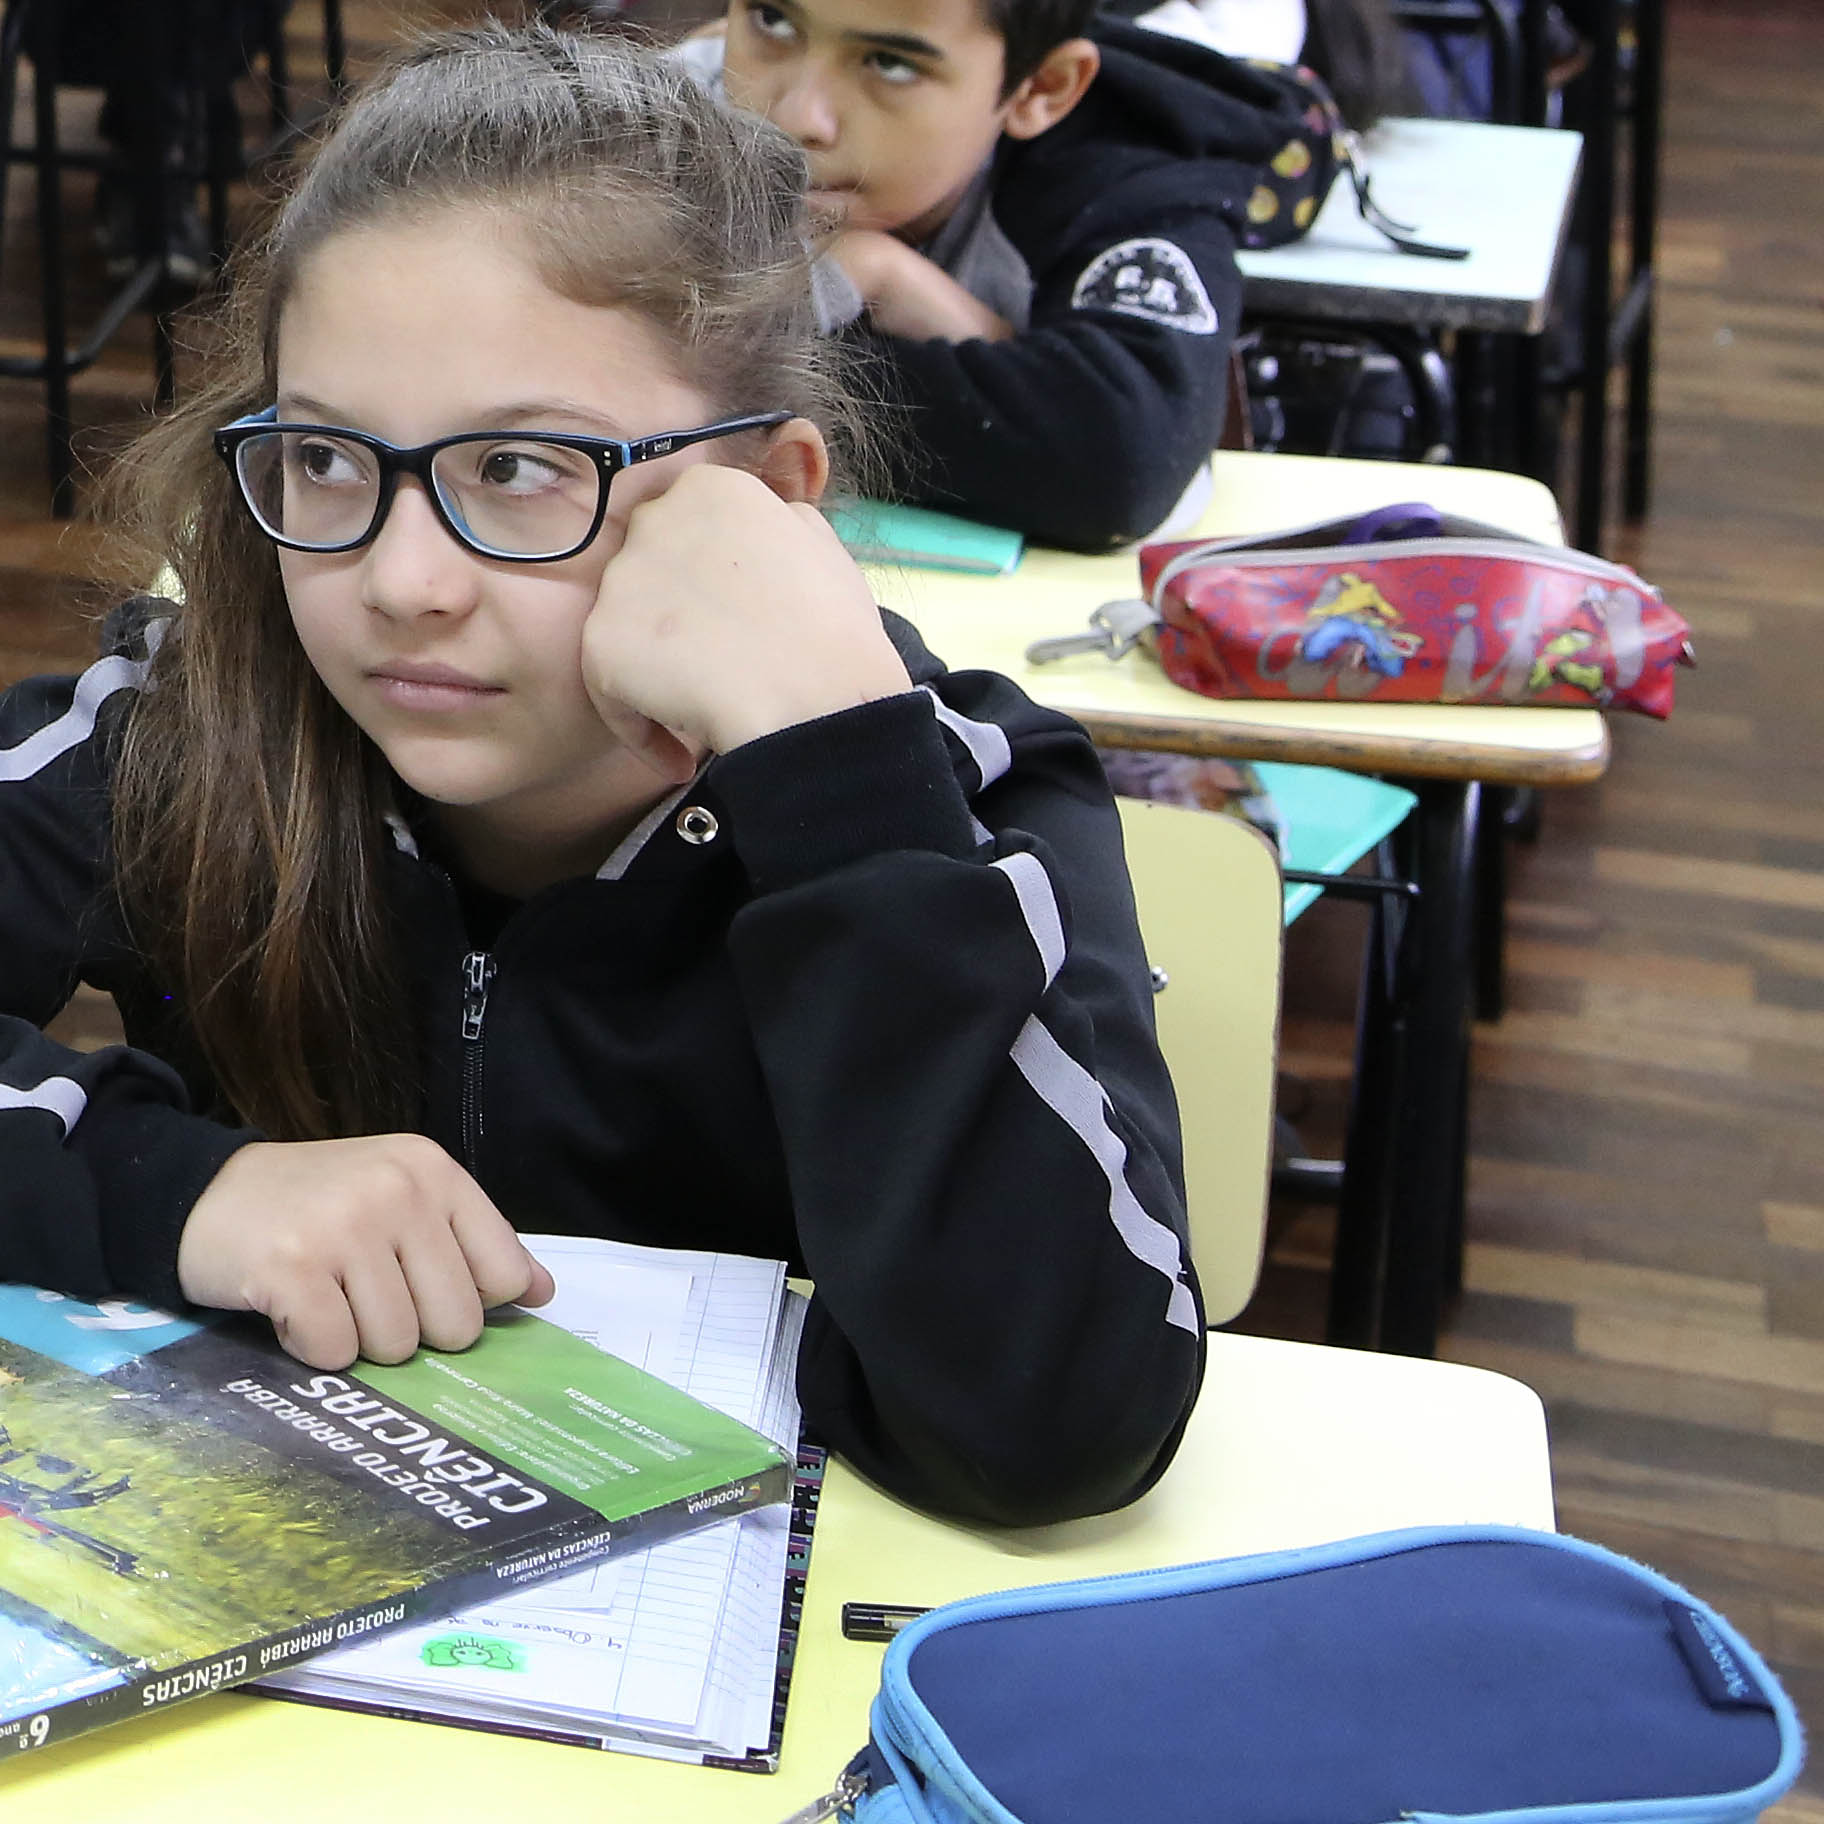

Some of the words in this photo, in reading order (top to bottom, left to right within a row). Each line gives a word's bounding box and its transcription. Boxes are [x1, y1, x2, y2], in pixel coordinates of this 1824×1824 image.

[219, 1379, 364, 1453] ARARIBÁ
[290, 1375, 549, 1514] CIÊNCIAS
[352, 1452, 491, 1531] PROJETO
[686, 1485, 746, 1515] MODERNA
[548, 1546, 563, 1560] DA
[563, 1530, 612, 1558] CIÊNCIAS
[495, 1551, 546, 1580] NATUREZA
[338, 1602, 406, 1642] PROJETO
[259, 1628, 334, 1671] ARARIBÁ
[142, 1655, 248, 1708] CIÊNCIAS
